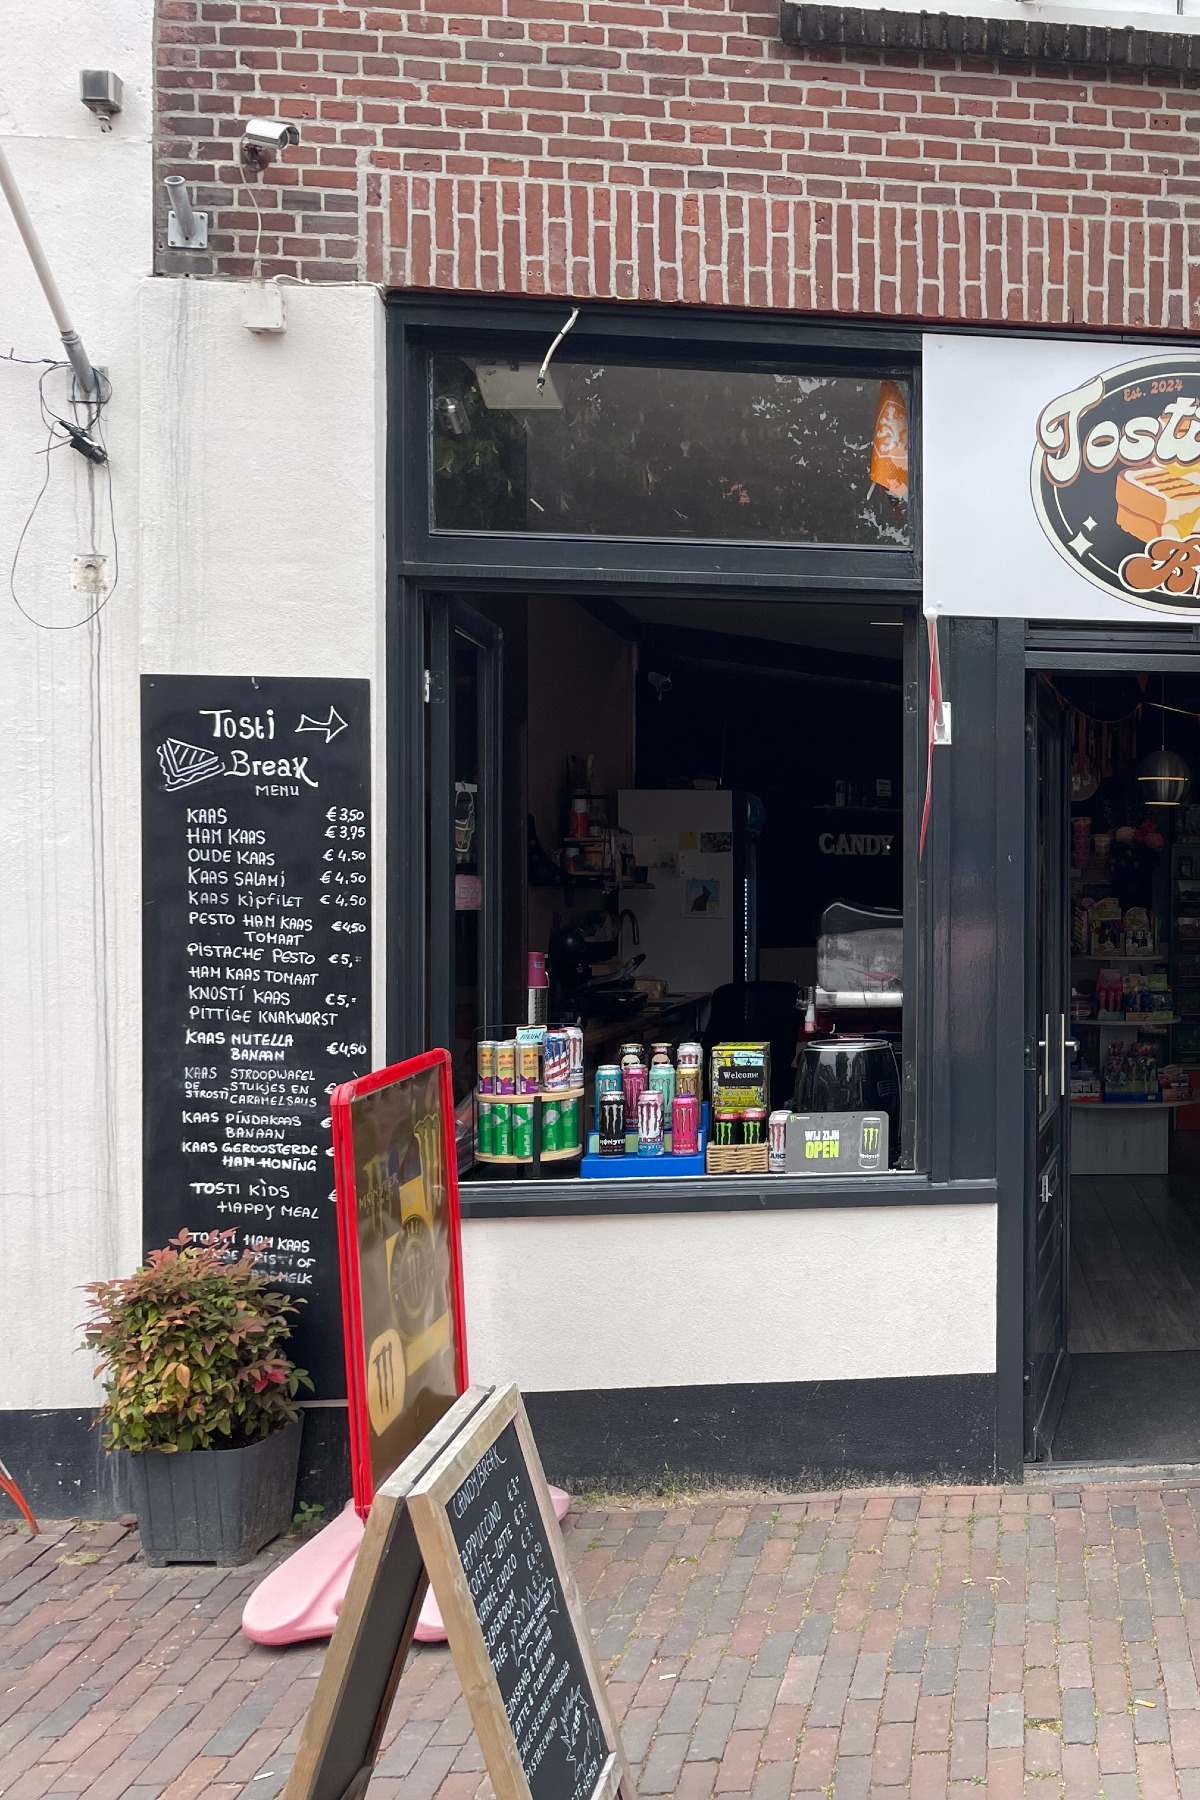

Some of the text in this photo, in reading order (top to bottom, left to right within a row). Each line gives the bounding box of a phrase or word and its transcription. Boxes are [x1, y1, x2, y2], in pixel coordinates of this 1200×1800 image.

[1124, 379, 1183, 402] Est. 2024
[198, 708, 274, 740] Tosti
[224, 750, 318, 788] Break
[256, 784, 300, 796] MENU
[186, 808, 228, 824] KAAS
[186, 828, 222, 844] HAM
[228, 828, 266, 846] KAAS
[818, 832, 894, 856] CANDY
[188, 848, 232, 862] OUDE
[236, 850, 276, 866] KAAS
[188, 866, 228, 884] KAAS
[188, 890, 230, 906] KAAS
[188, 912, 236, 926] PESTO
[242, 914, 276, 928] HAM
[280, 916, 312, 932] KAAS
[244, 930, 304, 946] TOMAAT
[272, 948, 316, 964] PESTO
[188, 966, 320, 986] HAM KAAS TOMAAT
[252, 988, 290, 1006] KAAS
[258, 1010, 338, 1026] KNAKWORST
[184, 1028, 294, 1048] KAAS NUTELLA
[230, 1048, 284, 1062] BANAAN
[184, 1066, 316, 1082] KAAS STROOPWAFEL
[184, 1080, 200, 1090] DE
[290, 1084, 310, 1094] EN
[182, 1110, 220, 1124] KAAS
[224, 1126, 286, 1140] BANAAN
[804, 1130, 839, 1140] WIJ ZIJN
[182, 1142, 218, 1152] KAAS
[222, 1142, 318, 1156] GEROOSTERDE
[805, 1141, 839, 1158] OPEN
[216, 1200, 320, 1220] HAPPY MEAL
[276, 1236, 310, 1254] KAAS
[296, 1258, 316, 1268] OF
